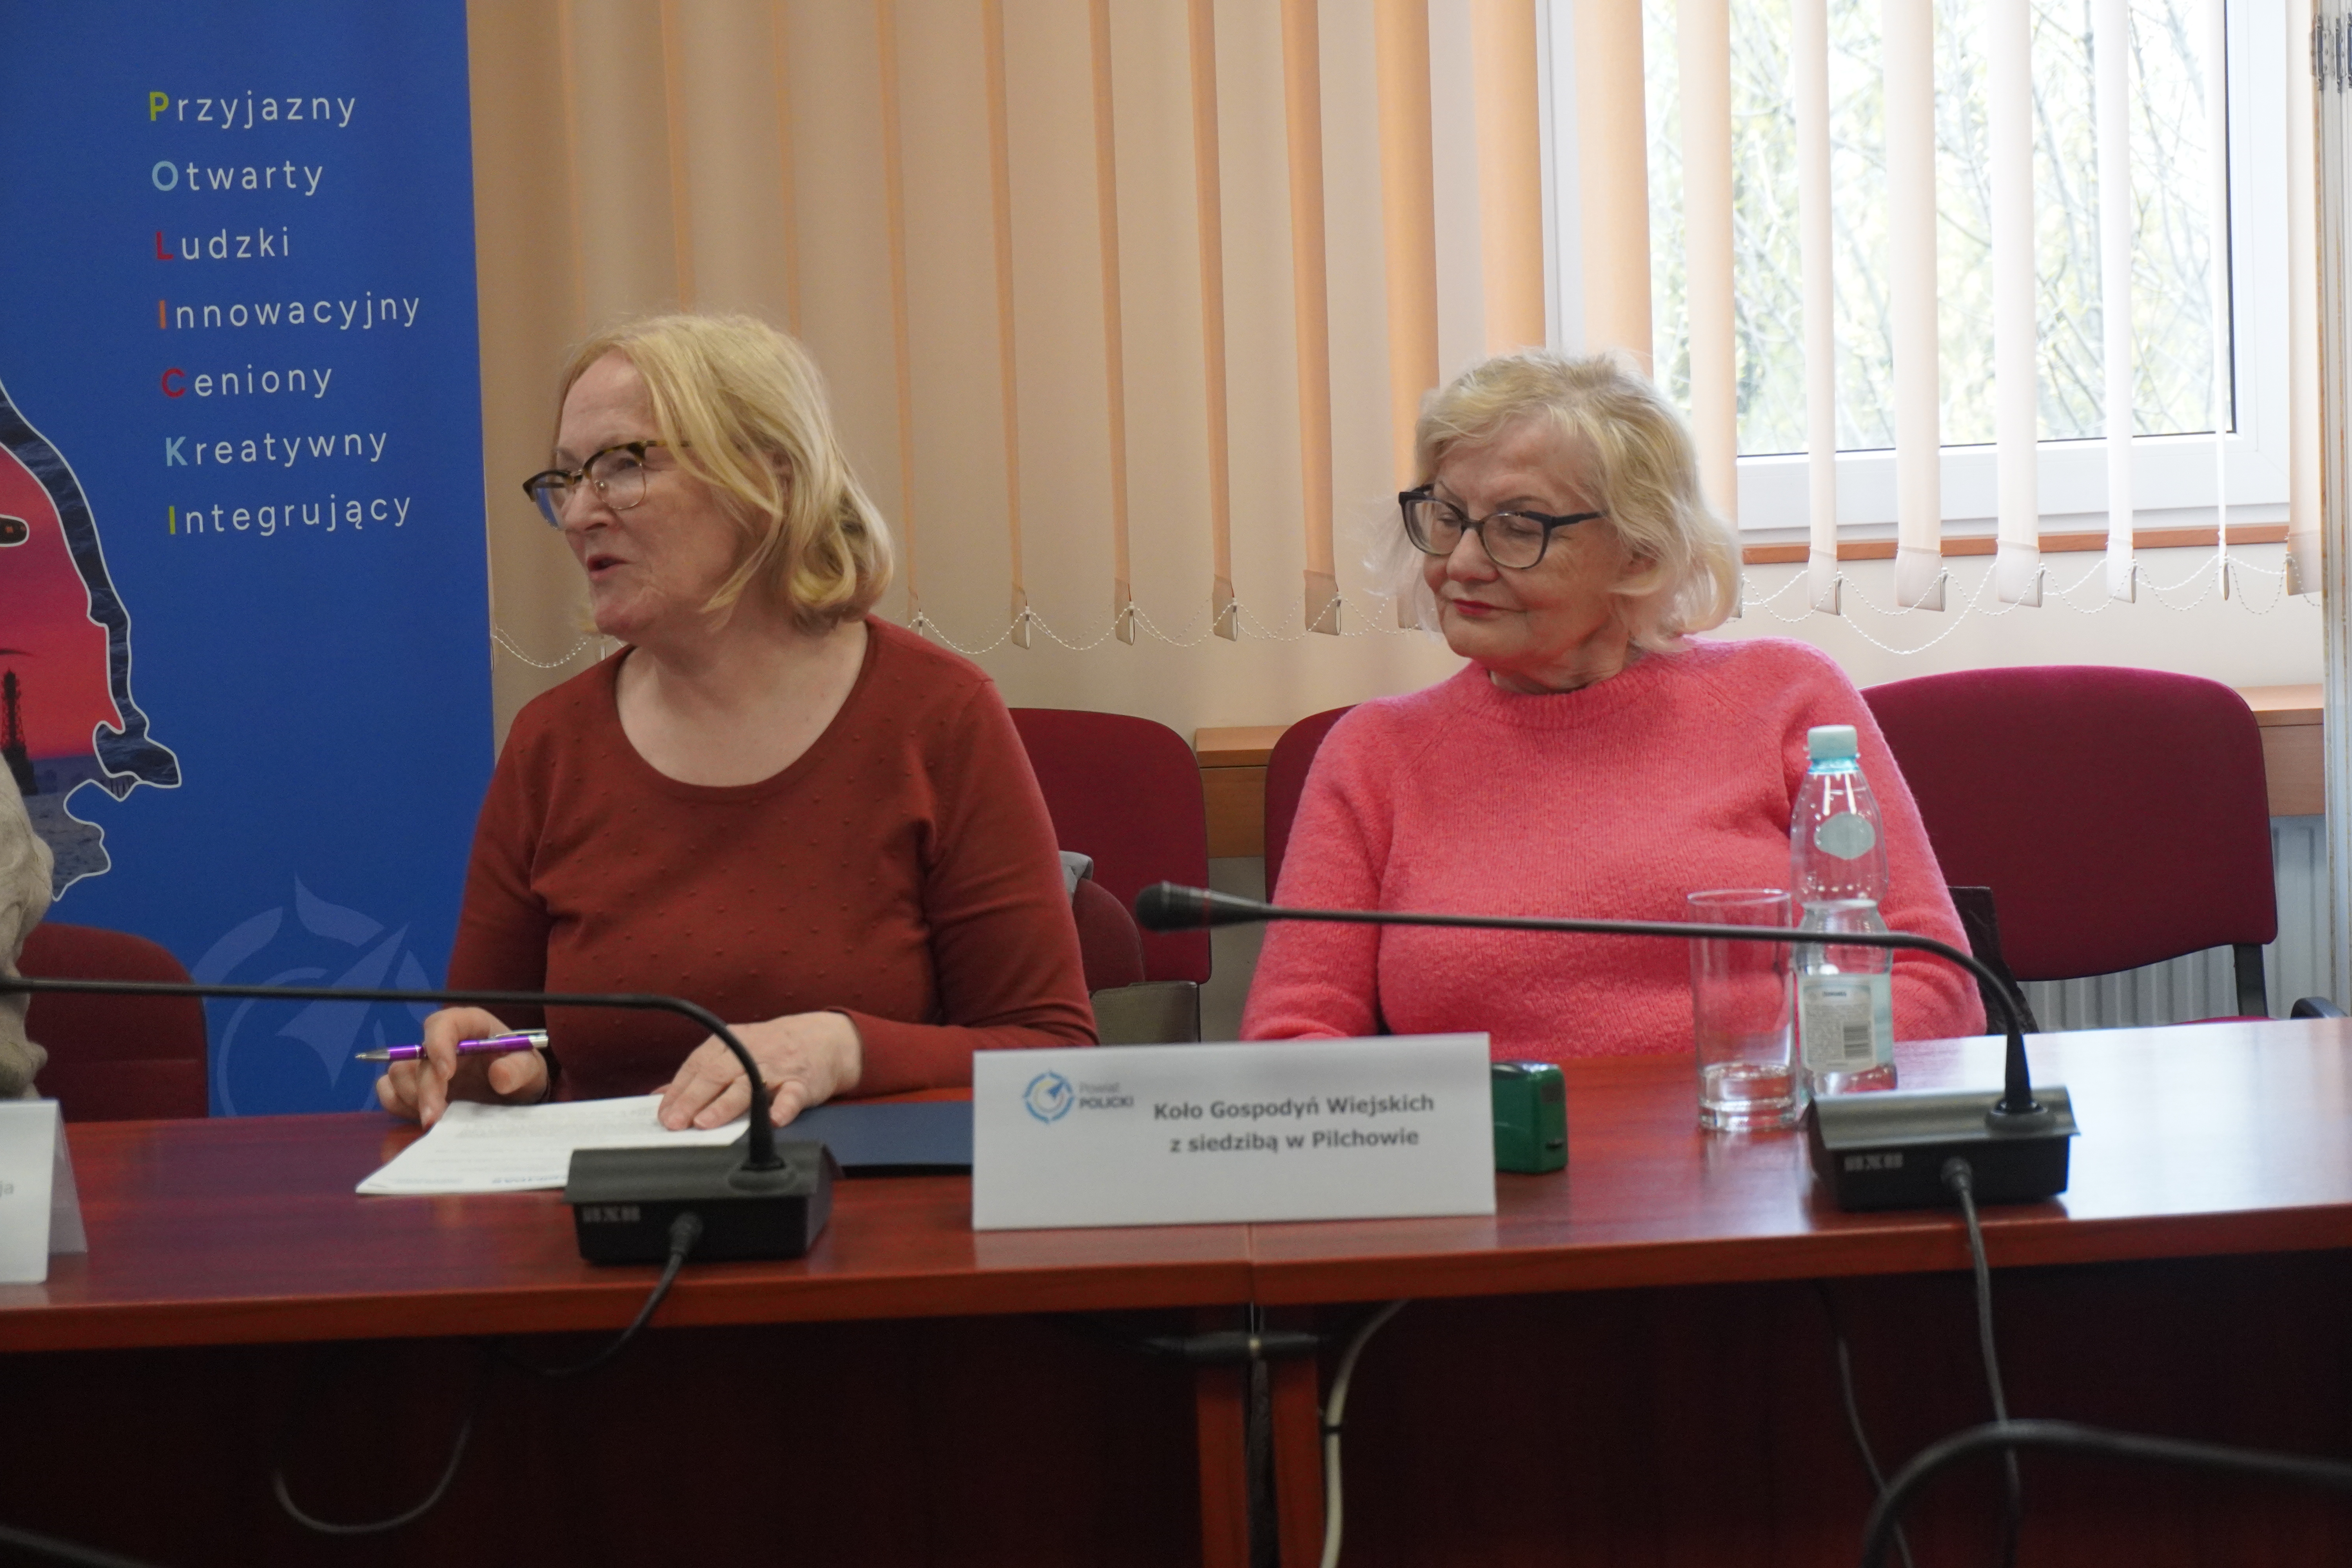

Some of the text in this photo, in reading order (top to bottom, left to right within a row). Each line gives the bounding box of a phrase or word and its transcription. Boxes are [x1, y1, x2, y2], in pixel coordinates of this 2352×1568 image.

[149, 90, 355, 129] Przyjazny
[152, 160, 323, 196] Otwarty
[156, 226, 289, 260] Ludzki
[158, 291, 419, 330] Innowacyjny
[160, 364, 332, 399] Ceniony
[165, 432, 387, 467] Kreatywny
[169, 494, 410, 536] Integrujący
[1079, 1096, 1135, 1109] POLICKI
[1154, 1094, 1434, 1121] Koło Gospodyń Wiejskich
[1170, 1127, 1419, 1154] z siedzibą w Pilchowie
